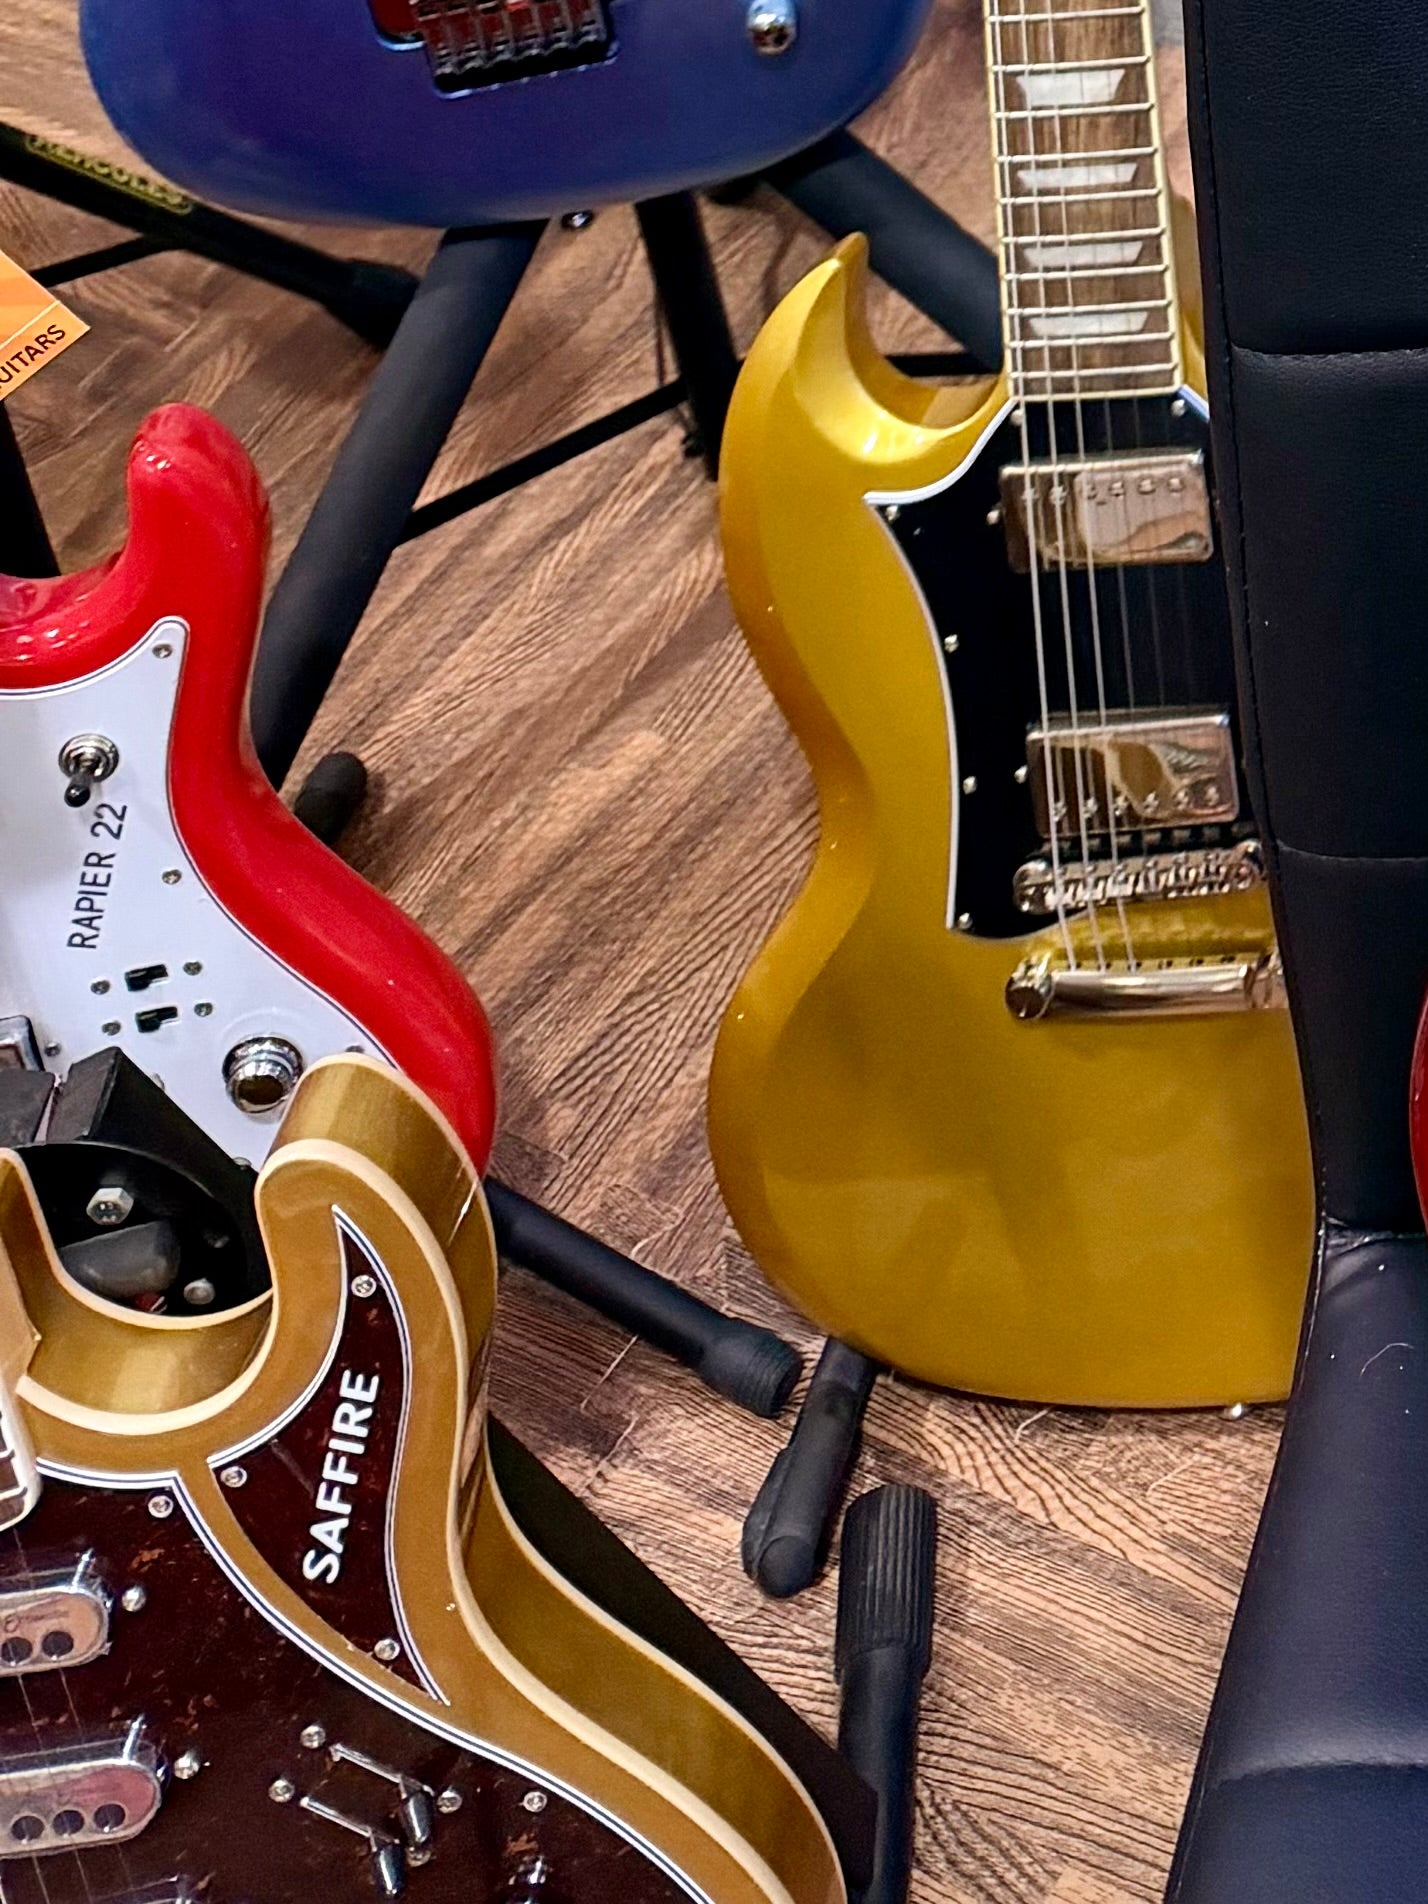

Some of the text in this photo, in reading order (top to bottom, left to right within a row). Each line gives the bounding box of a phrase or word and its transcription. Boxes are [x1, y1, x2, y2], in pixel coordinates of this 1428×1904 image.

[0, 324, 66, 389] UITARS
[66, 803, 128, 949] RAPIER 22
[302, 1369, 380, 1585] SAFFIRE
